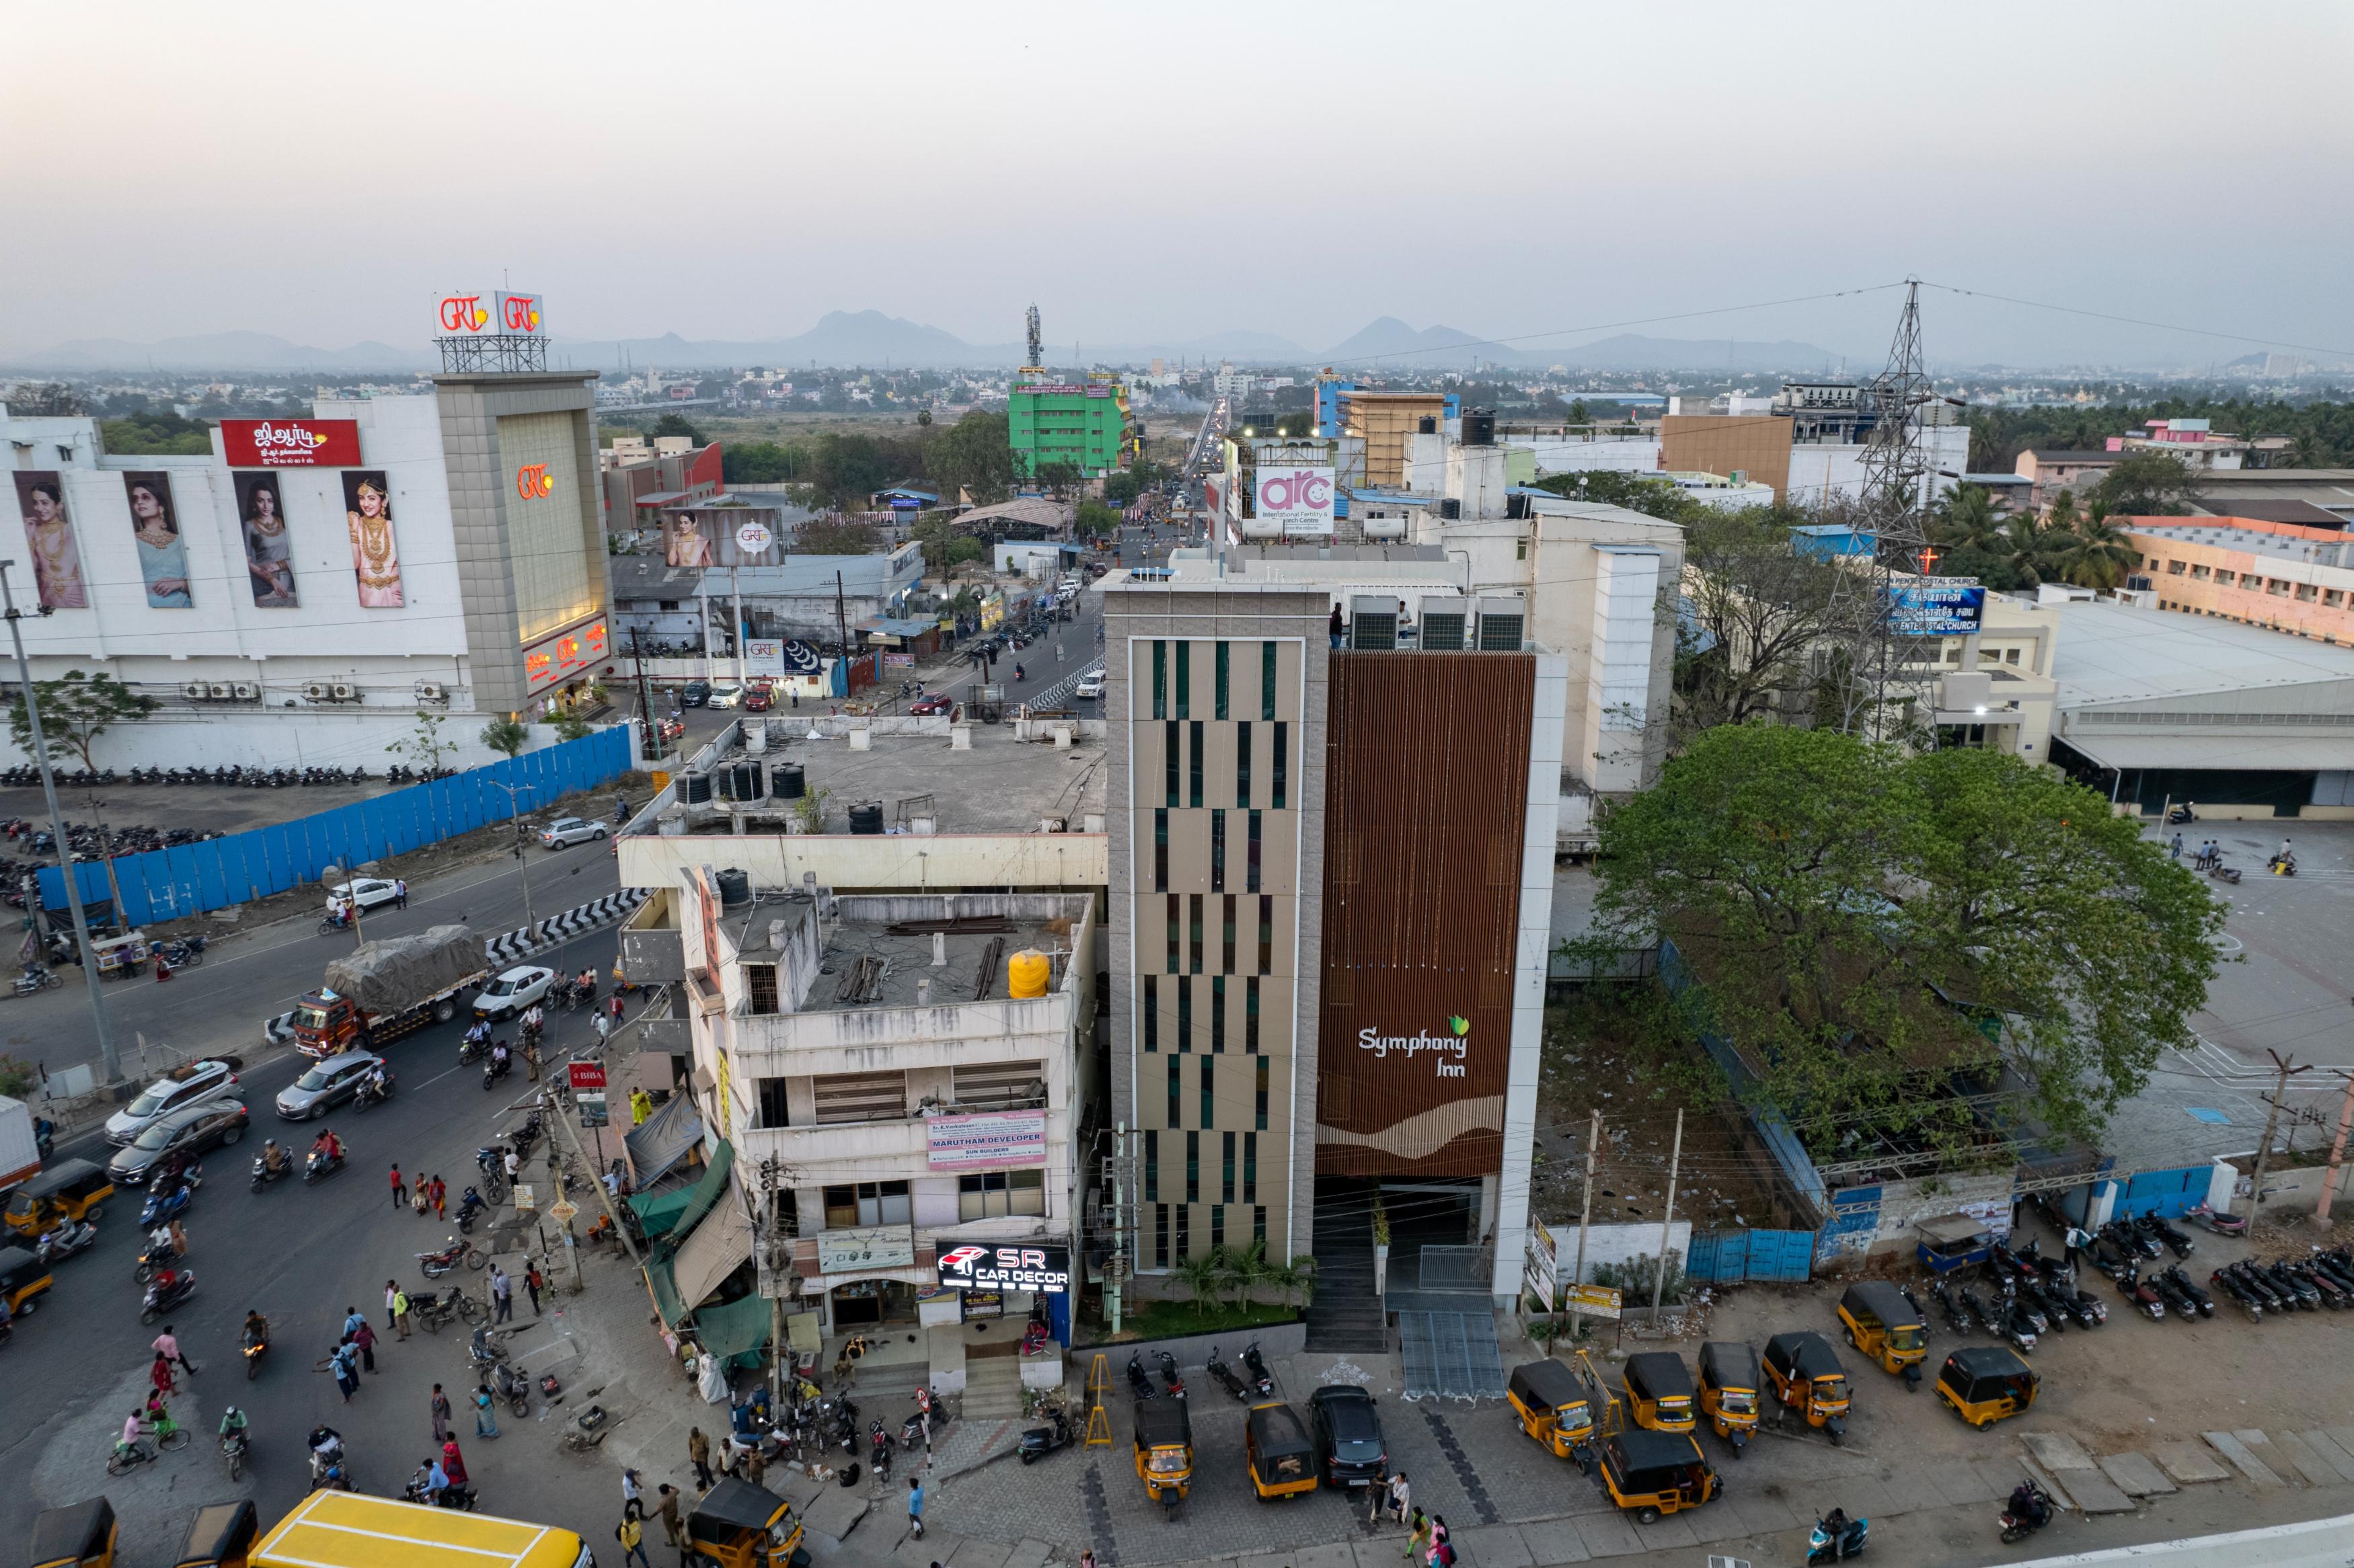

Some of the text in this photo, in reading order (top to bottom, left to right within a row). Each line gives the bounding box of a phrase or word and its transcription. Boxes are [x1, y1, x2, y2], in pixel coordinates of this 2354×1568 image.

[441, 296, 482, 331] GRT
[505, 297, 537, 332] GRT
[517, 463, 549, 500] GRT
[1261, 471, 1330, 510] arc
[742, 530, 764, 541] GRT
[1947, 621, 1977, 630] CHURCH
[557, 634, 576, 661] GRT
[751, 643, 775, 656] GRT
[1359, 1026, 1468, 1059] Symphony
[1437, 1056, 1466, 1077] Inn
[933, 1138, 985, 1147] MARUTHAM
[988, 1134, 1040, 1144] DEVELOPER
[1538, 1222, 1552, 1249] RENT
[996, 1248, 1046, 1269] SR
[975, 1268, 1068, 1284] CAR DECOR
